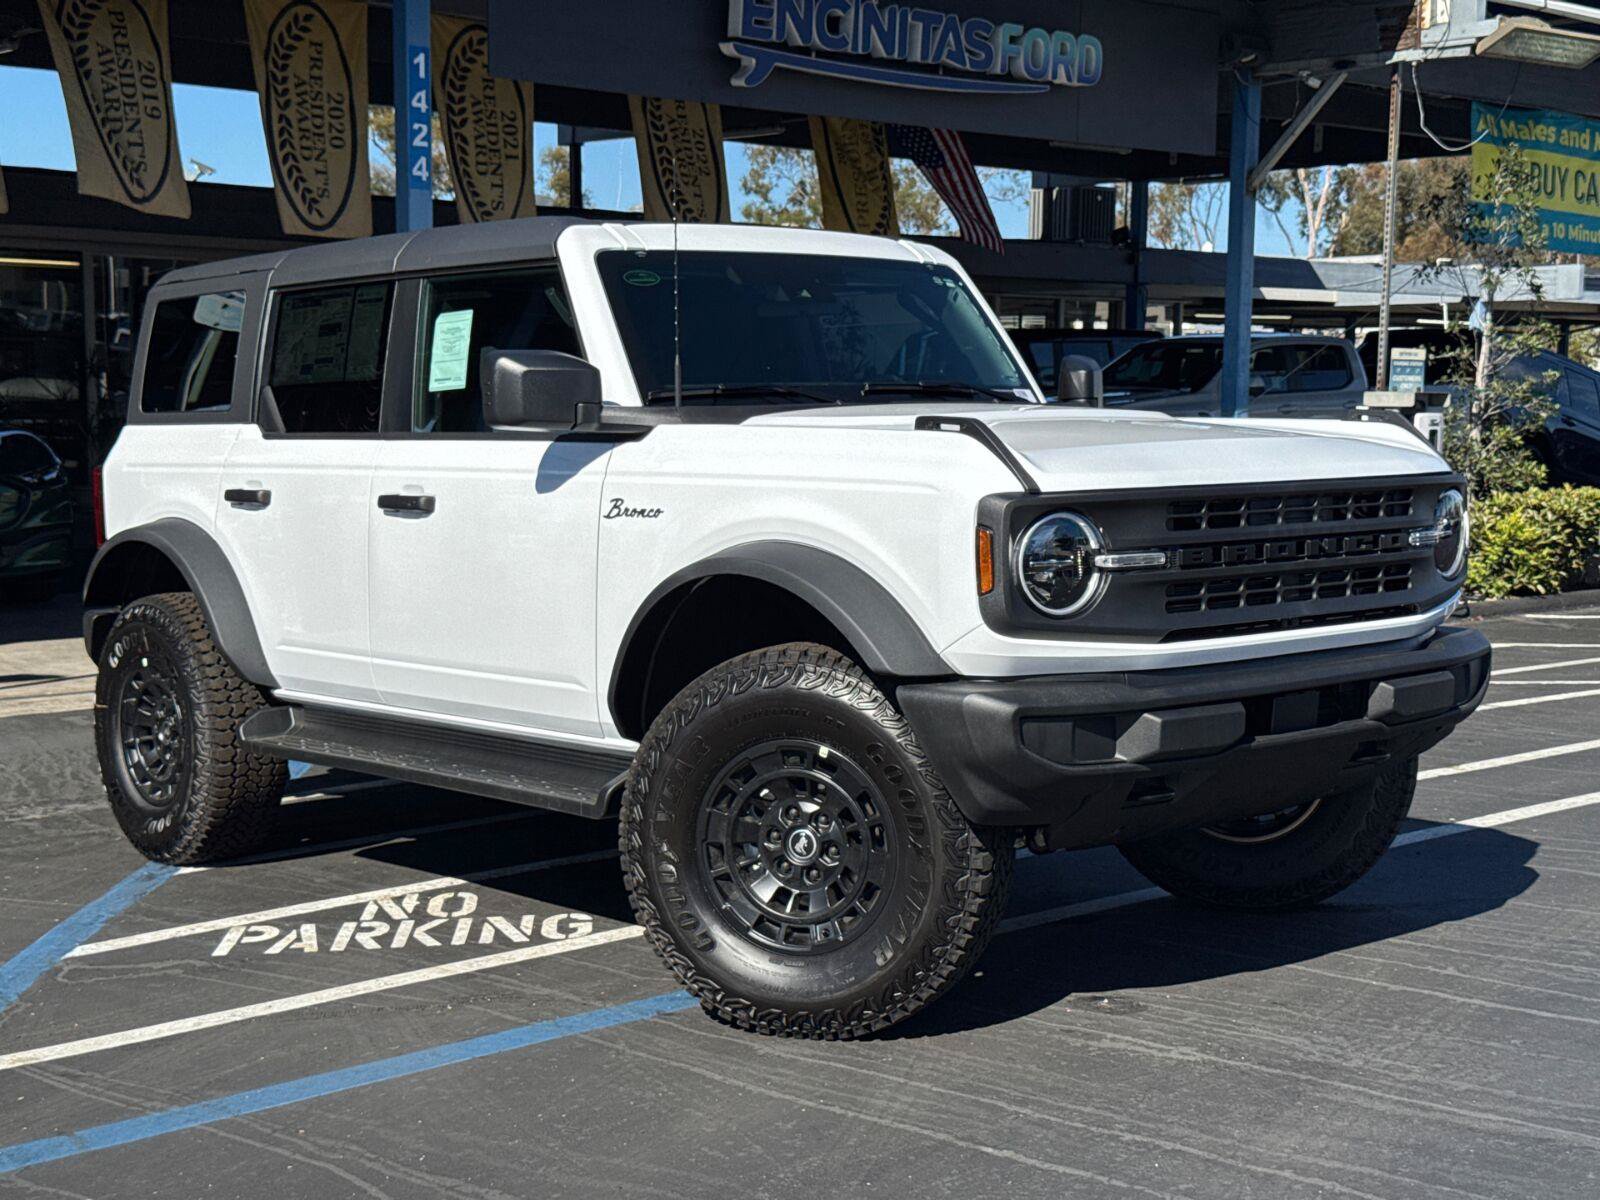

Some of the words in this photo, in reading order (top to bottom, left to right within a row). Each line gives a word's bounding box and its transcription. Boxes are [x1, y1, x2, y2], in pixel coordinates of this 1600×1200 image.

[728, 0, 996, 74] ENCINITAS
[993, 22, 1103, 88] FORD
[96, 42, 124, 136] AWARD
[108, 9, 148, 175] PRESIDENT'S
[137, 59, 162, 120] 2019
[293, 73, 314, 162] AWARD
[411, 52, 429, 182] 1424
[308, 40, 331, 200] PRESIDENT'S
[327, 92, 346, 150] 2020
[470, 94, 488, 176] AWARD
[500, 110, 520, 161] 2021
[1559, 127, 1590, 150] and
[675, 99, 707, 219] RESIDENT'S
[691, 128, 710, 177] 2022
[1529, 161, 1569, 200] BUY
[1553, 222, 1566, 238] 10
[603, 498, 664, 519] Bronco
[1177, 534, 1410, 567] BRONCO
[211, 913, 594, 957] PARKING
[359, 892, 479, 921] NO
